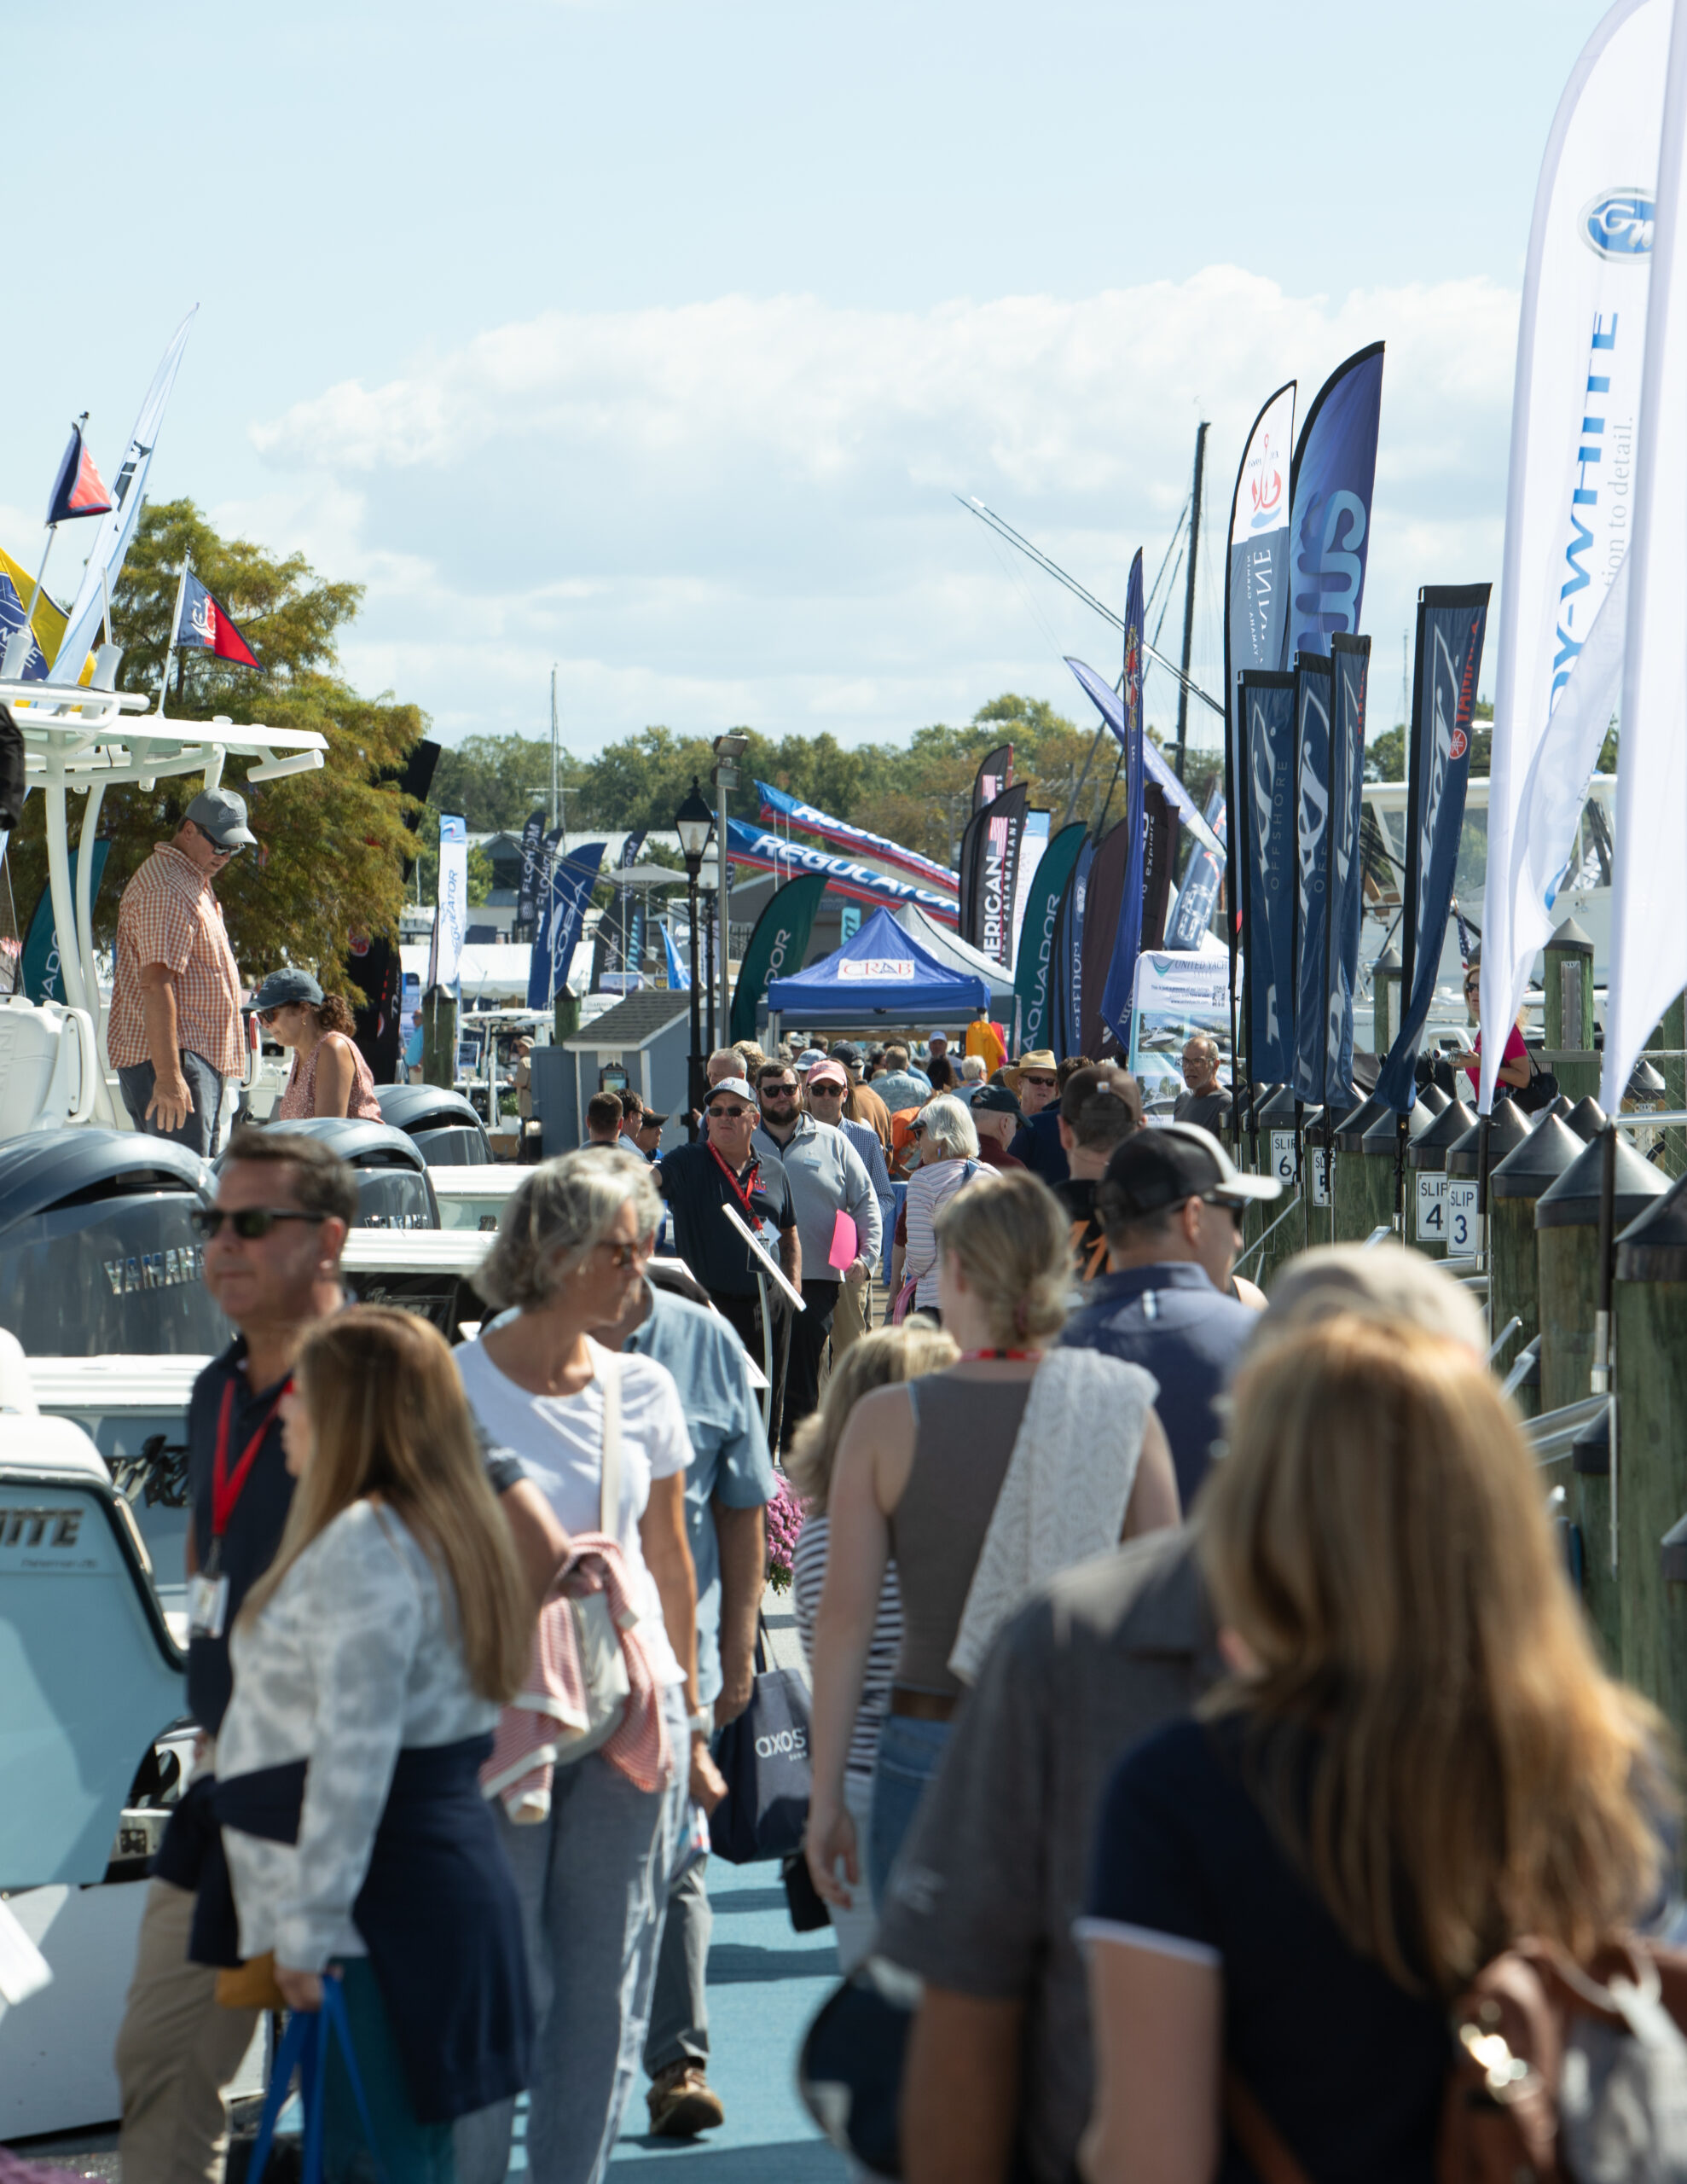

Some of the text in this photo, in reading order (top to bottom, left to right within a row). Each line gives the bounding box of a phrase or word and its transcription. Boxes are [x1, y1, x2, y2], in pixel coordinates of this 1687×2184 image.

[1607, 416, 1633, 497] detail.
[1609, 503, 1627, 529] to
[1270, 760, 1288, 891] OFFSHORE
[553, 880, 587, 973] COBIA
[843, 961, 912, 976] CRAB
[1022, 893, 1061, 1053] AQUADOR
[1174, 959, 1206, 970] UNITED
[1278, 1155, 1293, 1177] 6
[1421, 1182, 1448, 1197] SLIP
[1450, 1190, 1475, 1207] SLIP
[1425, 1203, 1444, 1231] 4
[1454, 1214, 1468, 1245] 3
